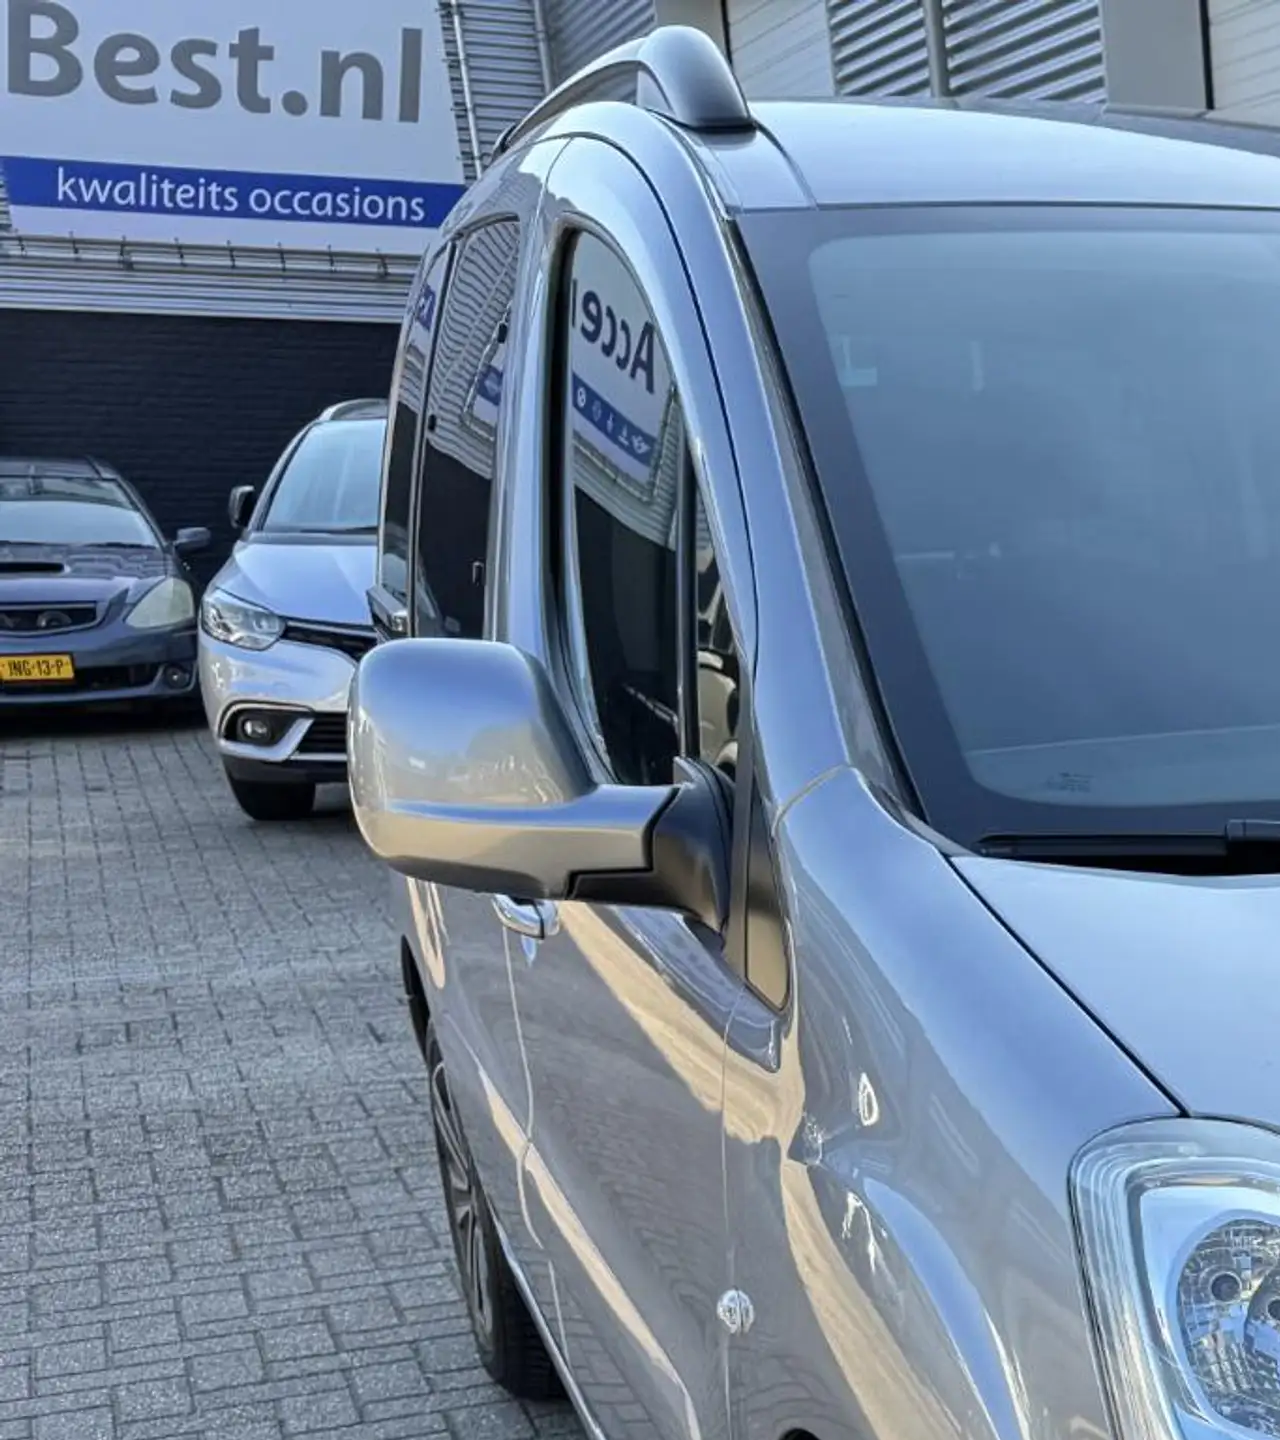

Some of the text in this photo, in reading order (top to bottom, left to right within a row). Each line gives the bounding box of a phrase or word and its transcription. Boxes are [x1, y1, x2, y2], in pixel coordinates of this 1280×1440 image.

[8, 0, 423, 123] Best.nl
[56, 166, 426, 222] kwaliteits occasions
